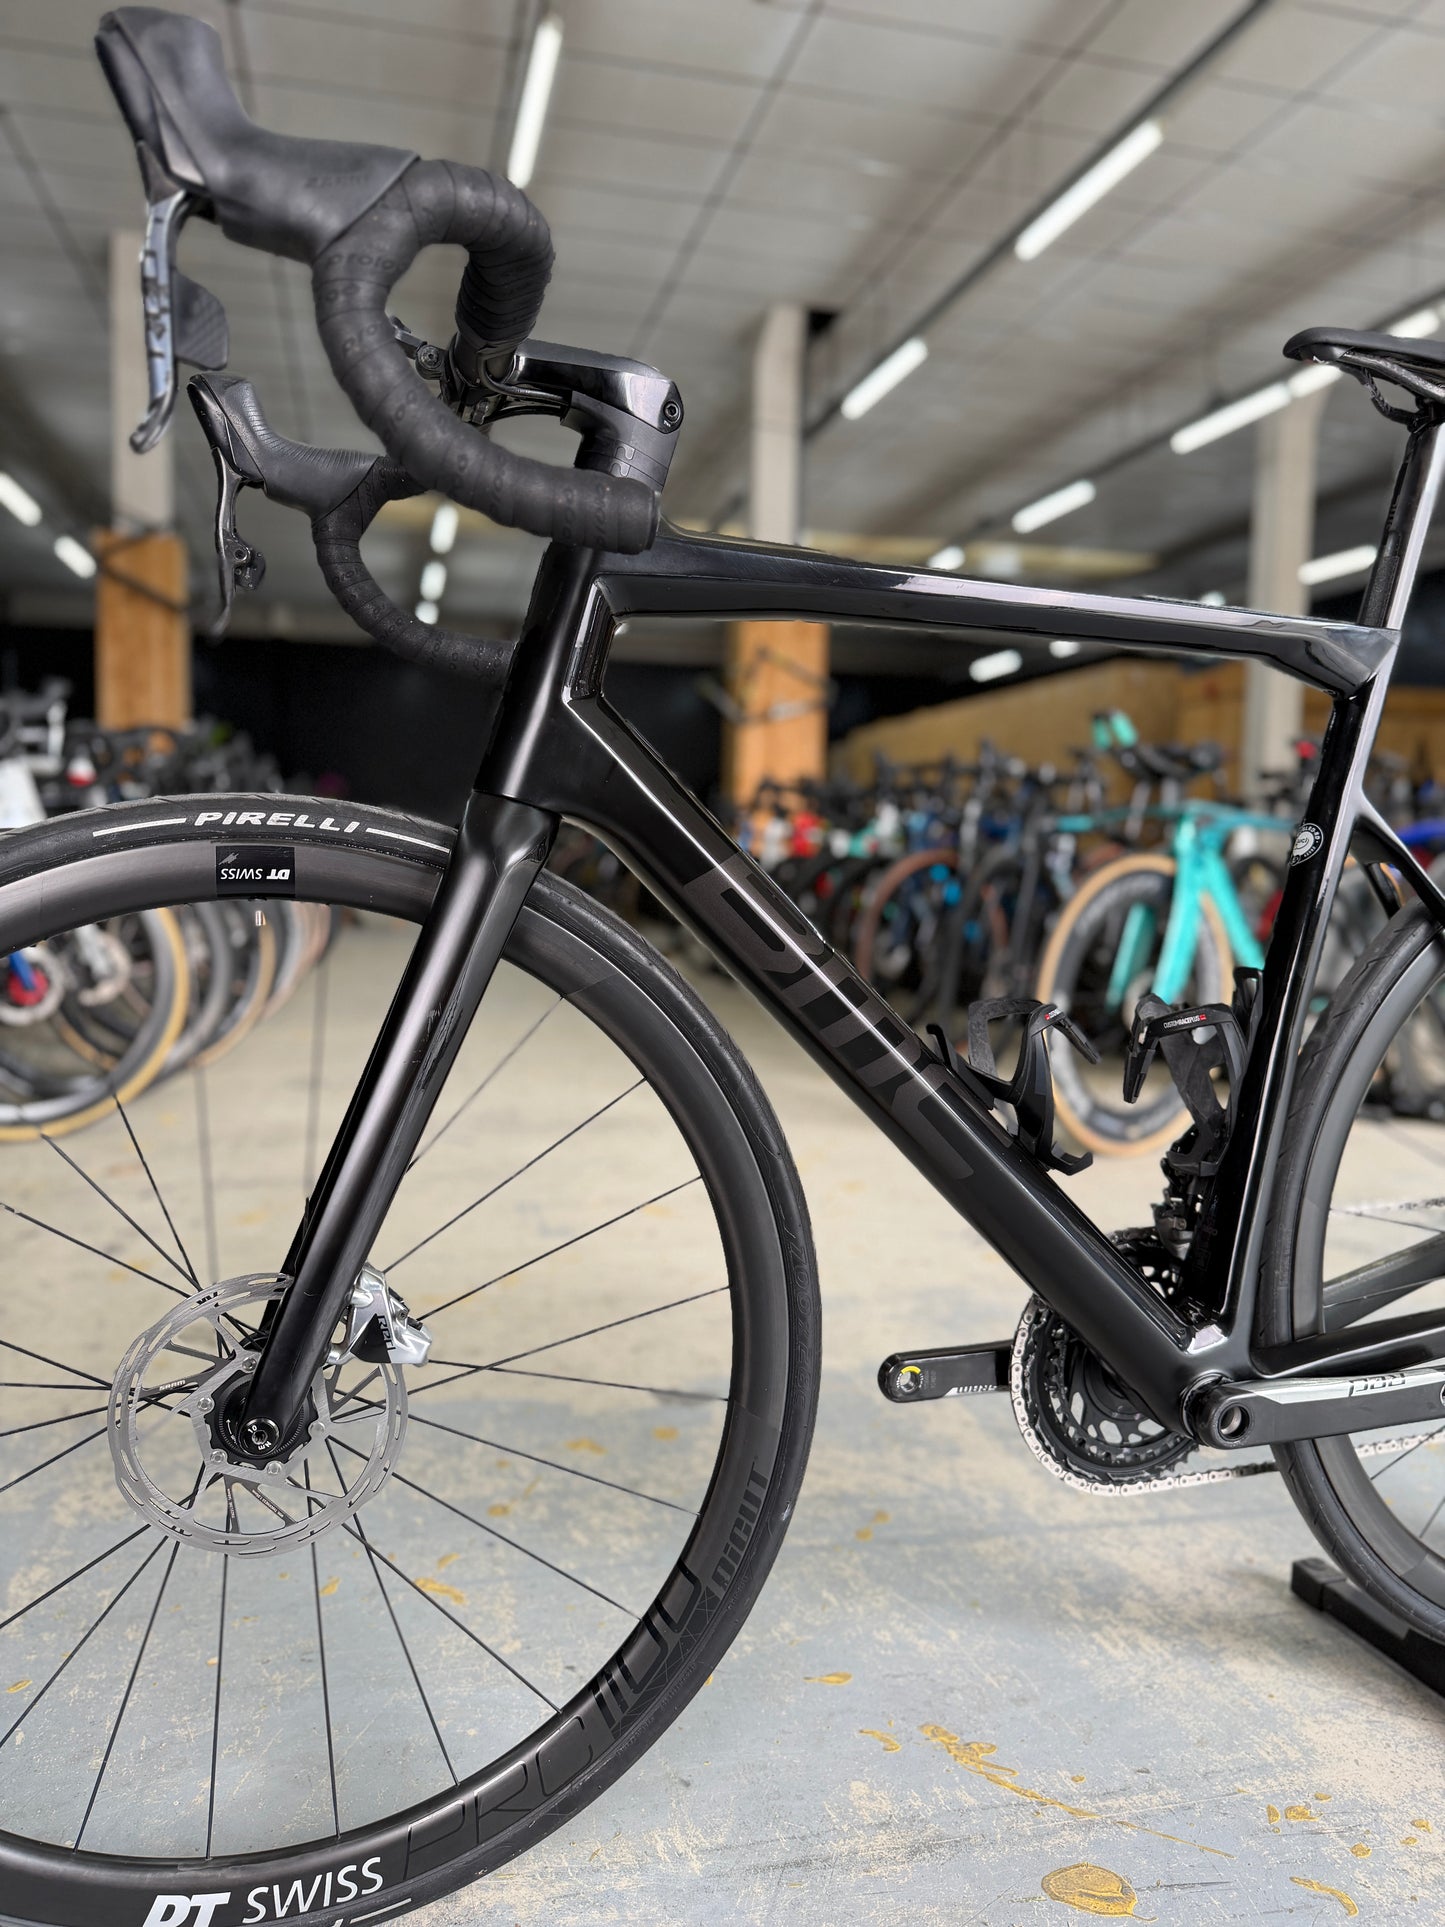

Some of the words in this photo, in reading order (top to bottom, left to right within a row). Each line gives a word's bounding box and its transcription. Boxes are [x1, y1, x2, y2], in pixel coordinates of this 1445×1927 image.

[194, 811, 360, 833] PIRELLI
[220, 868, 263, 880] SWISS
[266, 868, 291, 880] DT
[683, 849, 1014, 1180] BMC
[247, 1424, 257, 1433] 10
[257, 1440, 271, 1450] Nm
[242, 1857, 384, 1923] SWISS
